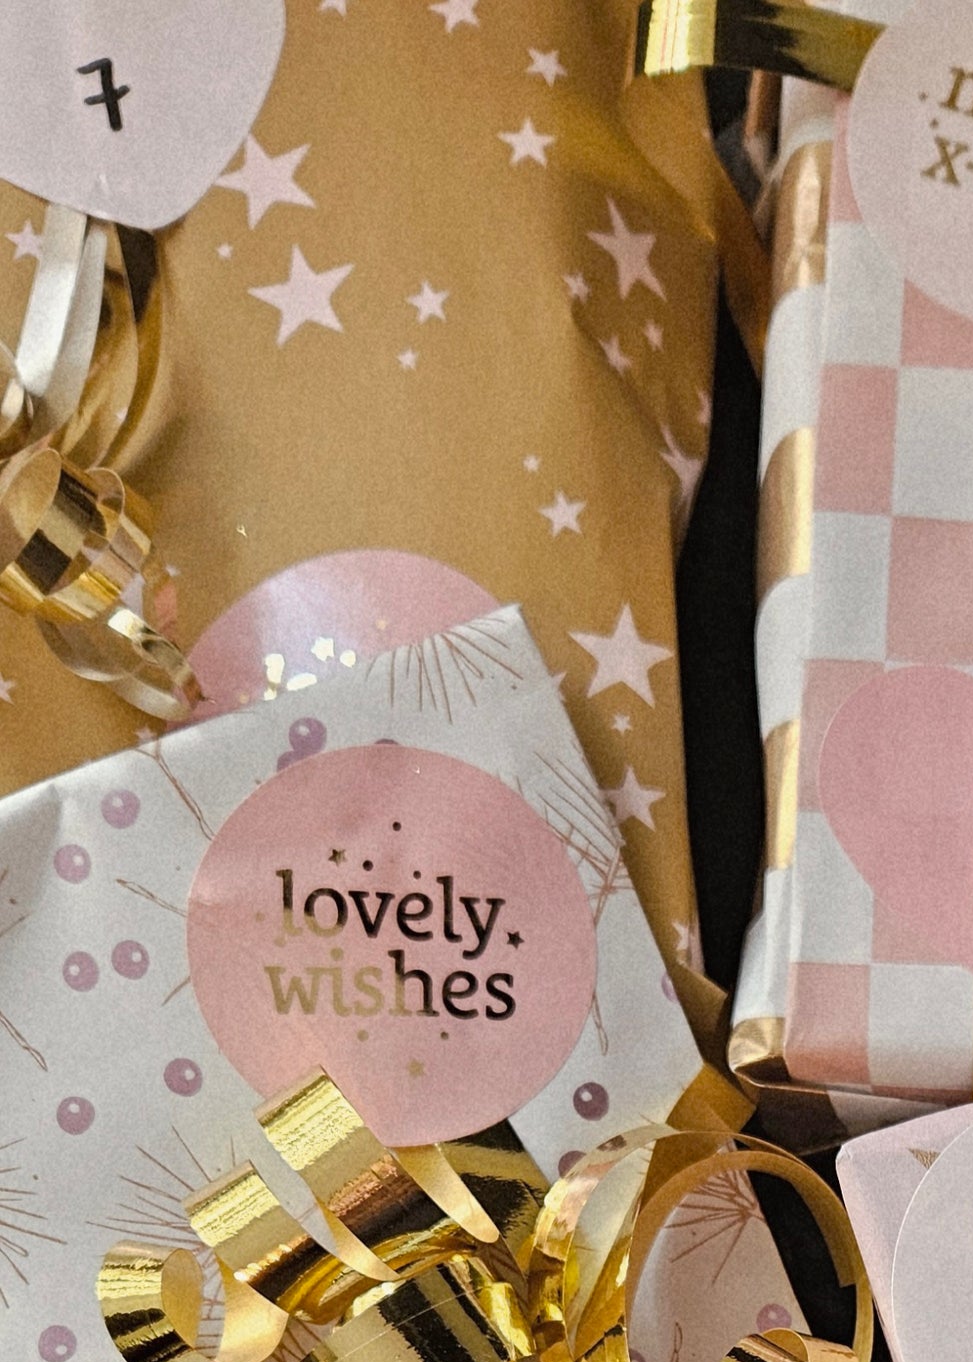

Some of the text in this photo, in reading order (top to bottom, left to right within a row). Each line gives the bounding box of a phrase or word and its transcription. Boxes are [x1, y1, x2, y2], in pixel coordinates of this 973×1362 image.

[77, 58, 130, 131] 7
[276, 869, 506, 959] lovely
[264, 950, 516, 1020] wishes
